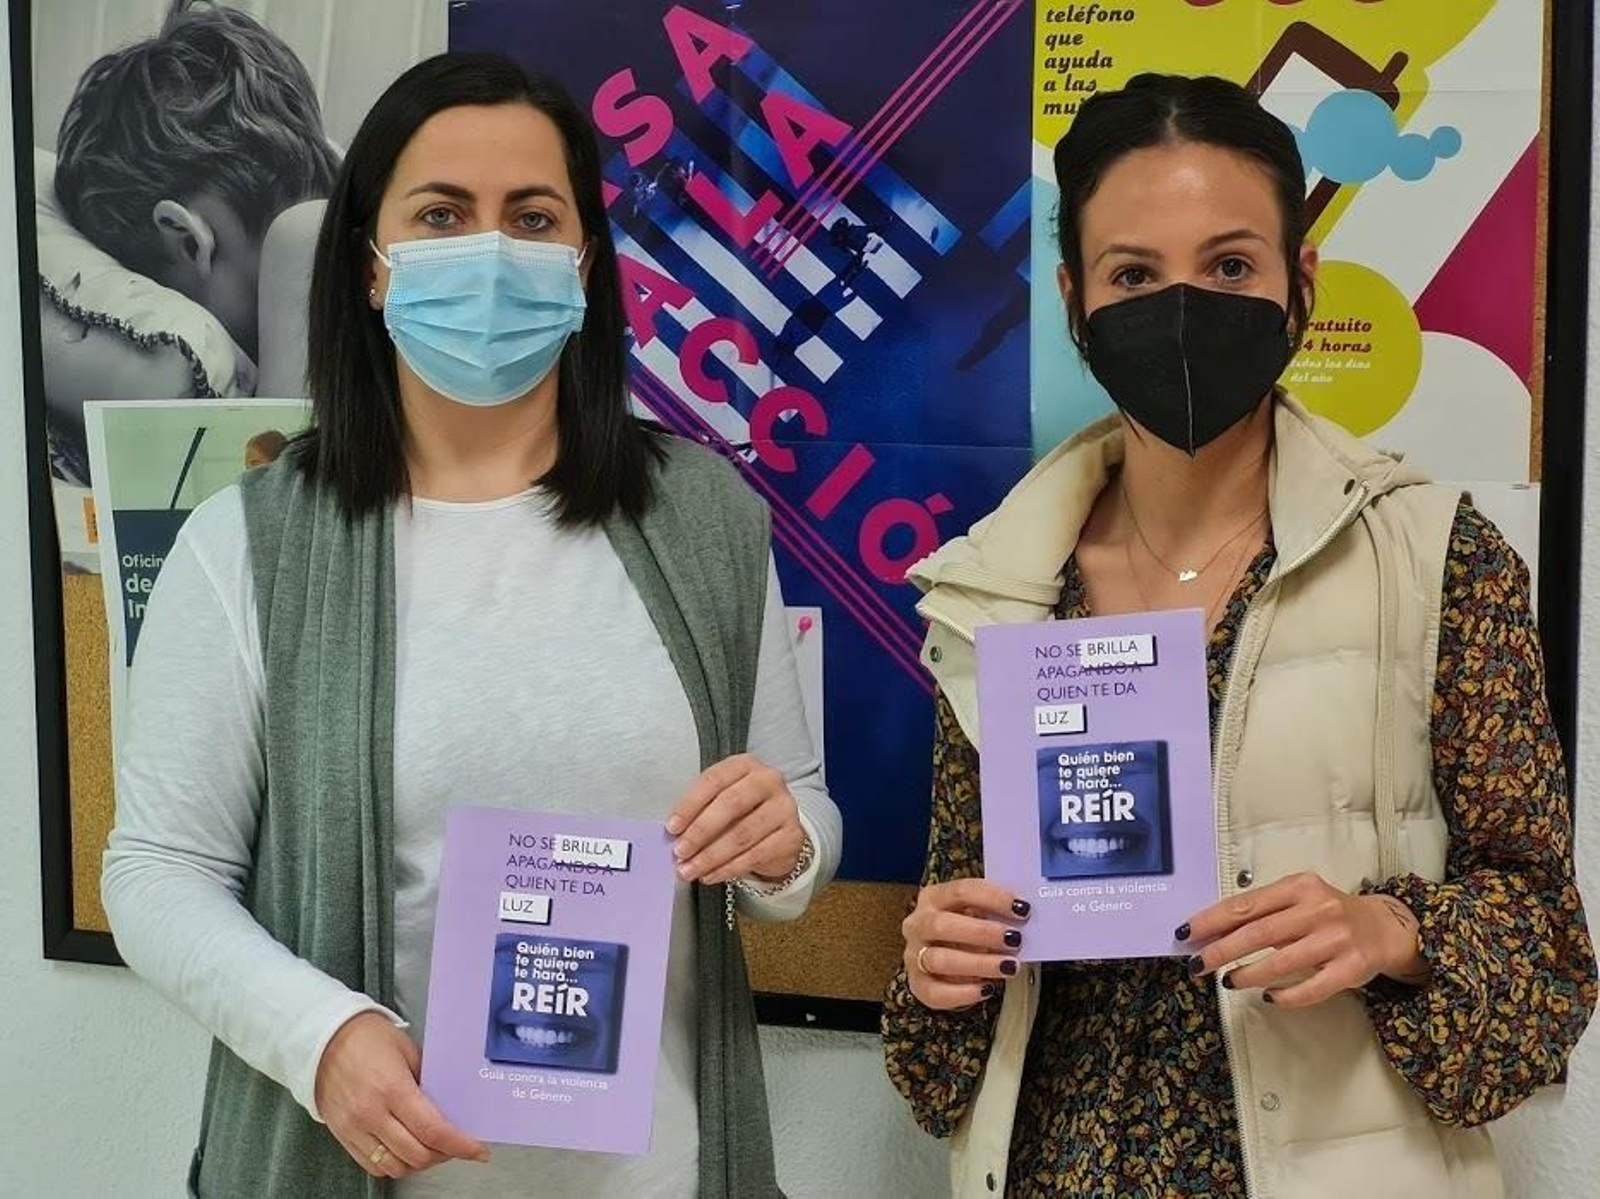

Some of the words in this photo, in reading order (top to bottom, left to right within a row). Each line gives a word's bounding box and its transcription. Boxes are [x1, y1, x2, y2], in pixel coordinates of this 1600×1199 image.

[1046, 4, 1135, 24] teléfono
[1045, 33, 1083, 51] que
[1044, 50, 1113, 74] ayuda
[1043, 80, 1057, 92] a
[1065, 73, 1097, 92] las
[1043, 98, 1084, 115] mu
[1320, 338, 1371, 353] horas
[122, 554, 164, 568] Oficin
[126, 573, 152, 593] de
[128, 599, 146, 618] In
[1035, 644, 1061, 659] NO
[1066, 643, 1082, 657] SE
[1087, 640, 1138, 656] BRILLA
[1036, 662, 1127, 680] APAGANDO
[1037, 686, 1088, 702] QUIEN
[1091, 683, 1109, 696] TE
[1114, 682, 1138, 696] DA
[1038, 711, 1069, 725] LUZ
[1058, 752, 1100, 766] Quién
[1104, 750, 1135, 764] bien
[1058, 766, 1072, 778] te
[1076, 764, 1121, 779] quiere
[1058, 779, 1073, 791] te
[509, 833, 536, 848] NO
[541, 837, 556, 850] SE
[561, 838, 613, 855] BRILLA
[506, 854, 598, 875] APAGANDO
[505, 874, 556, 891] QUIEN
[560, 879, 578, 893] TE
[583, 881, 605, 896] DA
[1119, 881, 1168, 894] violencia
[502, 898, 534, 913] LUZ
[1071, 901, 1086, 913] de
[516, 941, 559, 957] Quién
[564, 946, 595, 960] bien
[515, 954, 529, 967] te
[533, 957, 579, 972] quiere
[514, 966, 528, 979] te
[512, 1086, 526, 1099] de
